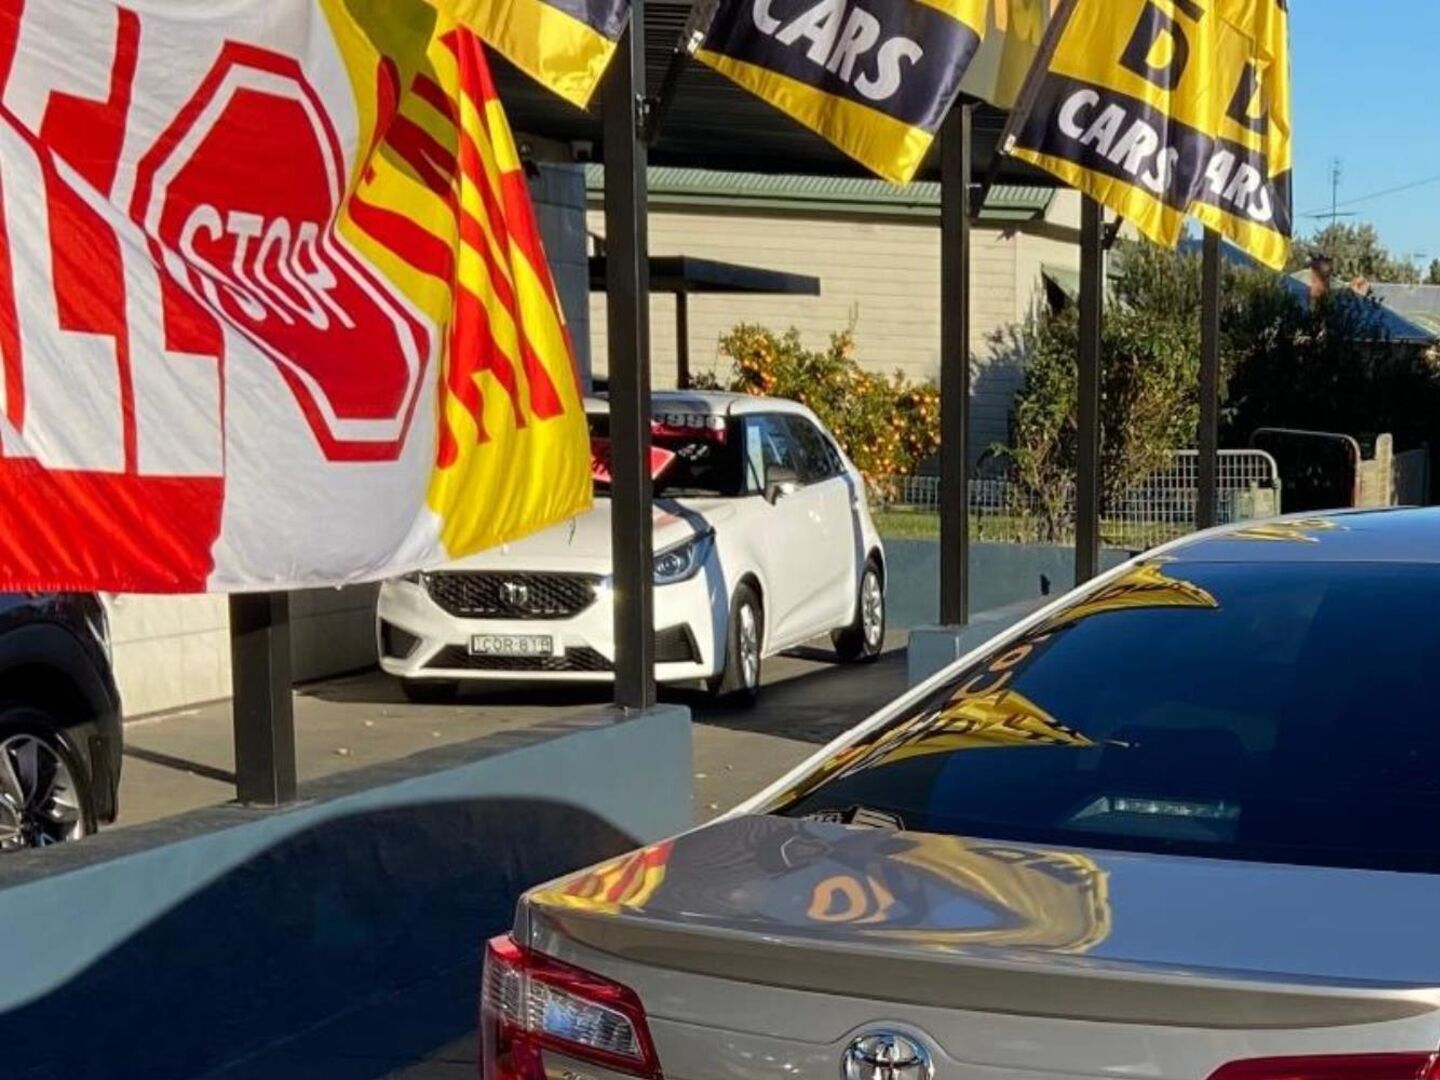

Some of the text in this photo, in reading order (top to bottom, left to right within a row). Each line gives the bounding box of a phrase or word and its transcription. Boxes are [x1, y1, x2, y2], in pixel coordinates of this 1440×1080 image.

[1058, 89, 1179, 193] CARS
[1204, 149, 1272, 222] ARS
[179, 204, 356, 330] STOP
